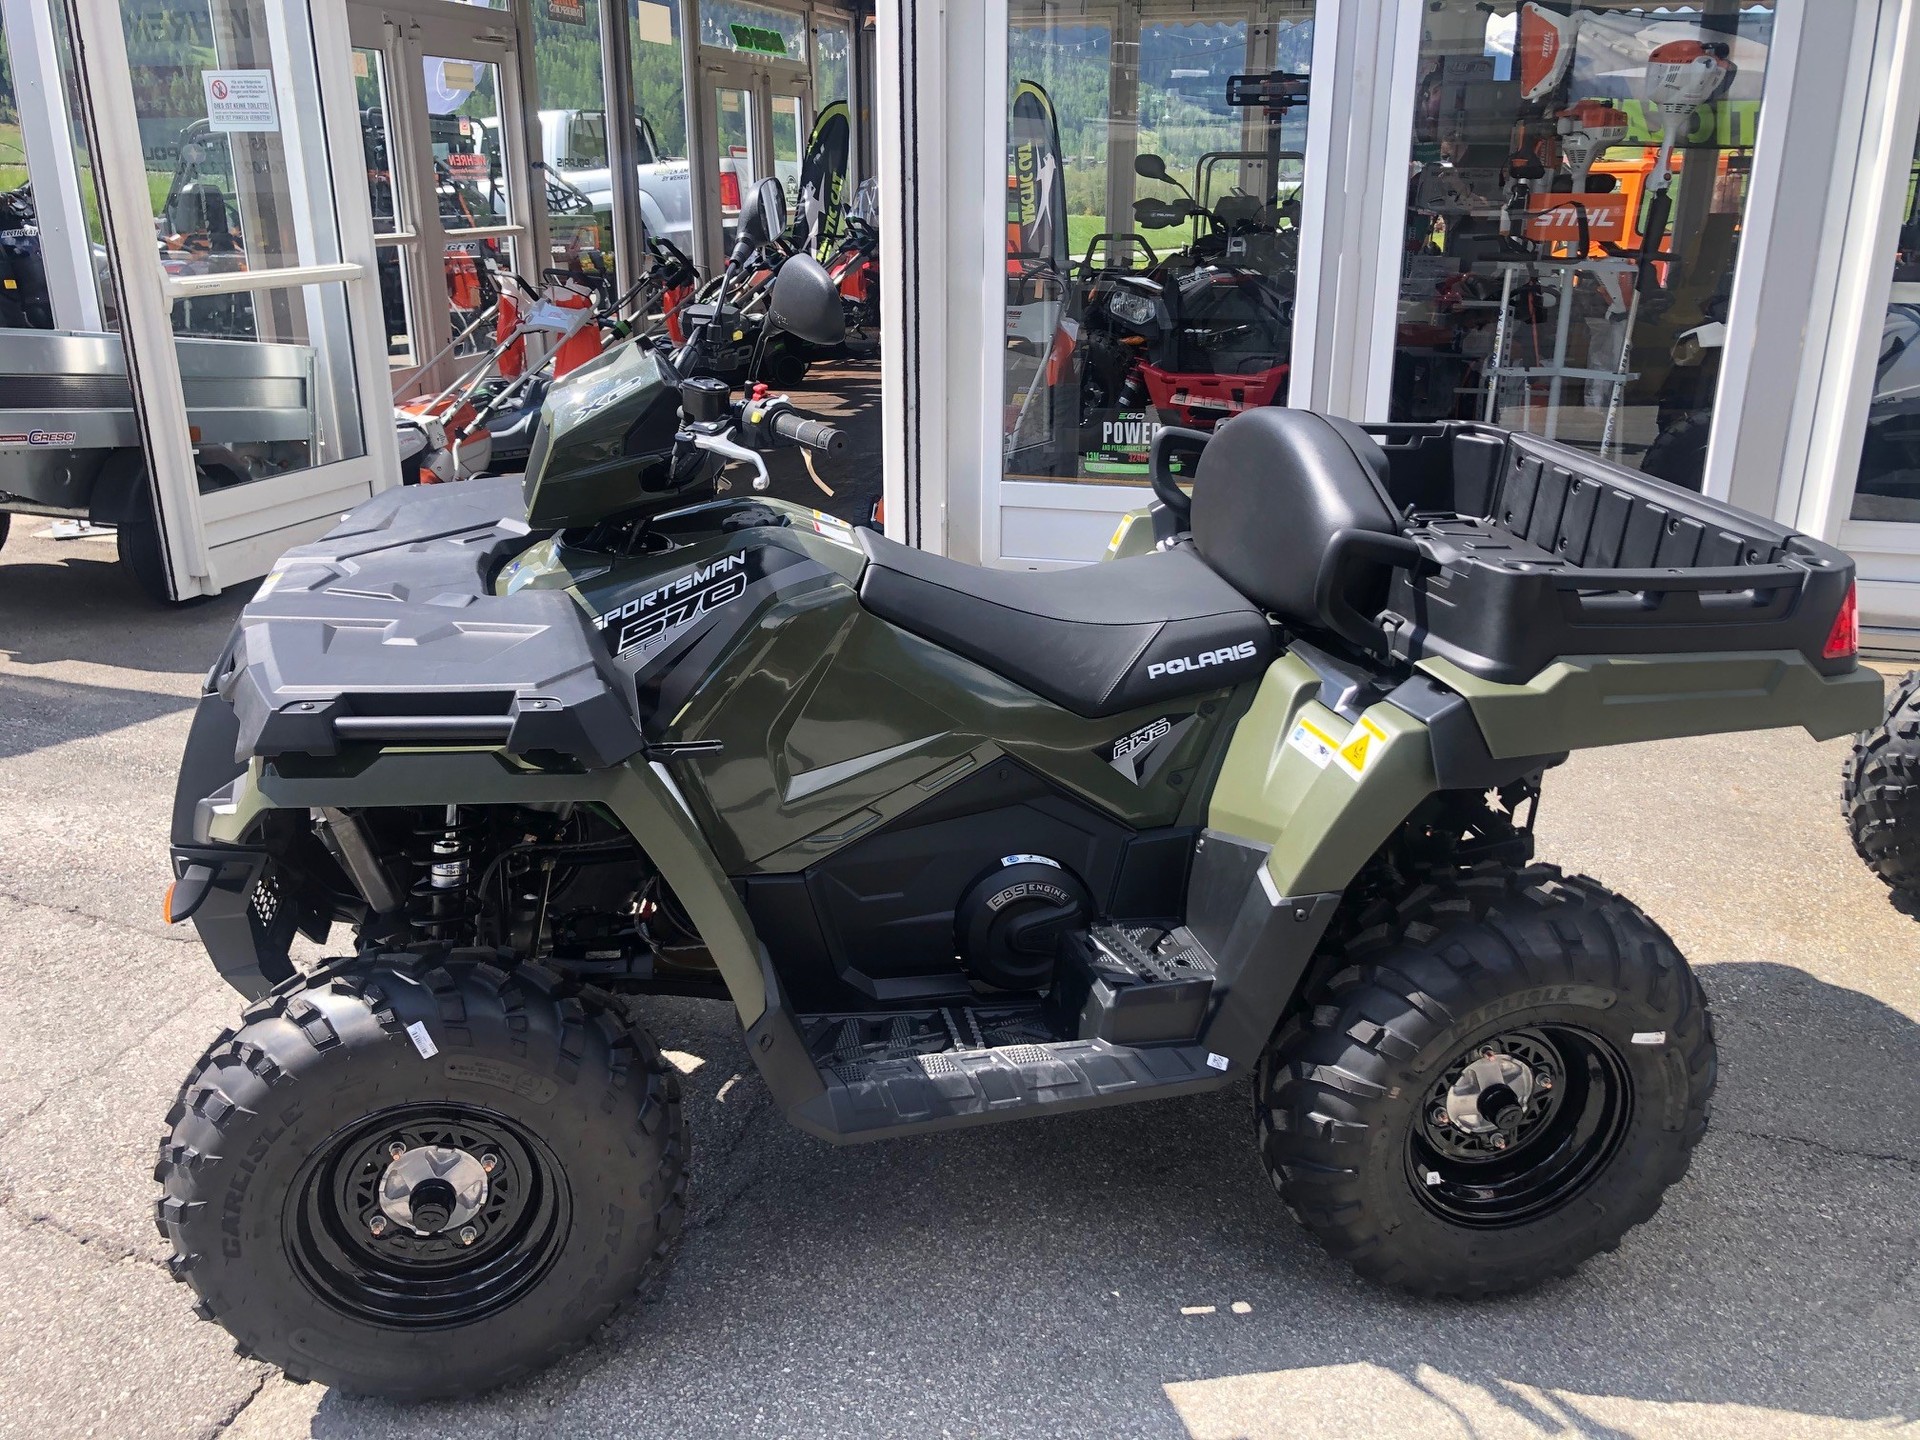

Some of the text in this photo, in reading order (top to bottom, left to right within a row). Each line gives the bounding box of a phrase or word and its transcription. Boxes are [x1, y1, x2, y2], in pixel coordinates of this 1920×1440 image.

[1542, 32, 1552, 57] STIHL
[1118, 412, 1145, 420] EGO
[592, 549, 746, 631] SPORTSMAN
[617, 571, 748, 655] 570
[623, 634, 668, 662] EFI
[1147, 640, 1258, 680] POLARIS
[1113, 721, 1171, 760] AWD
[991, 883, 1069, 908] EBS ENGINE
[221, 1101, 305, 1259] CARLISLE
